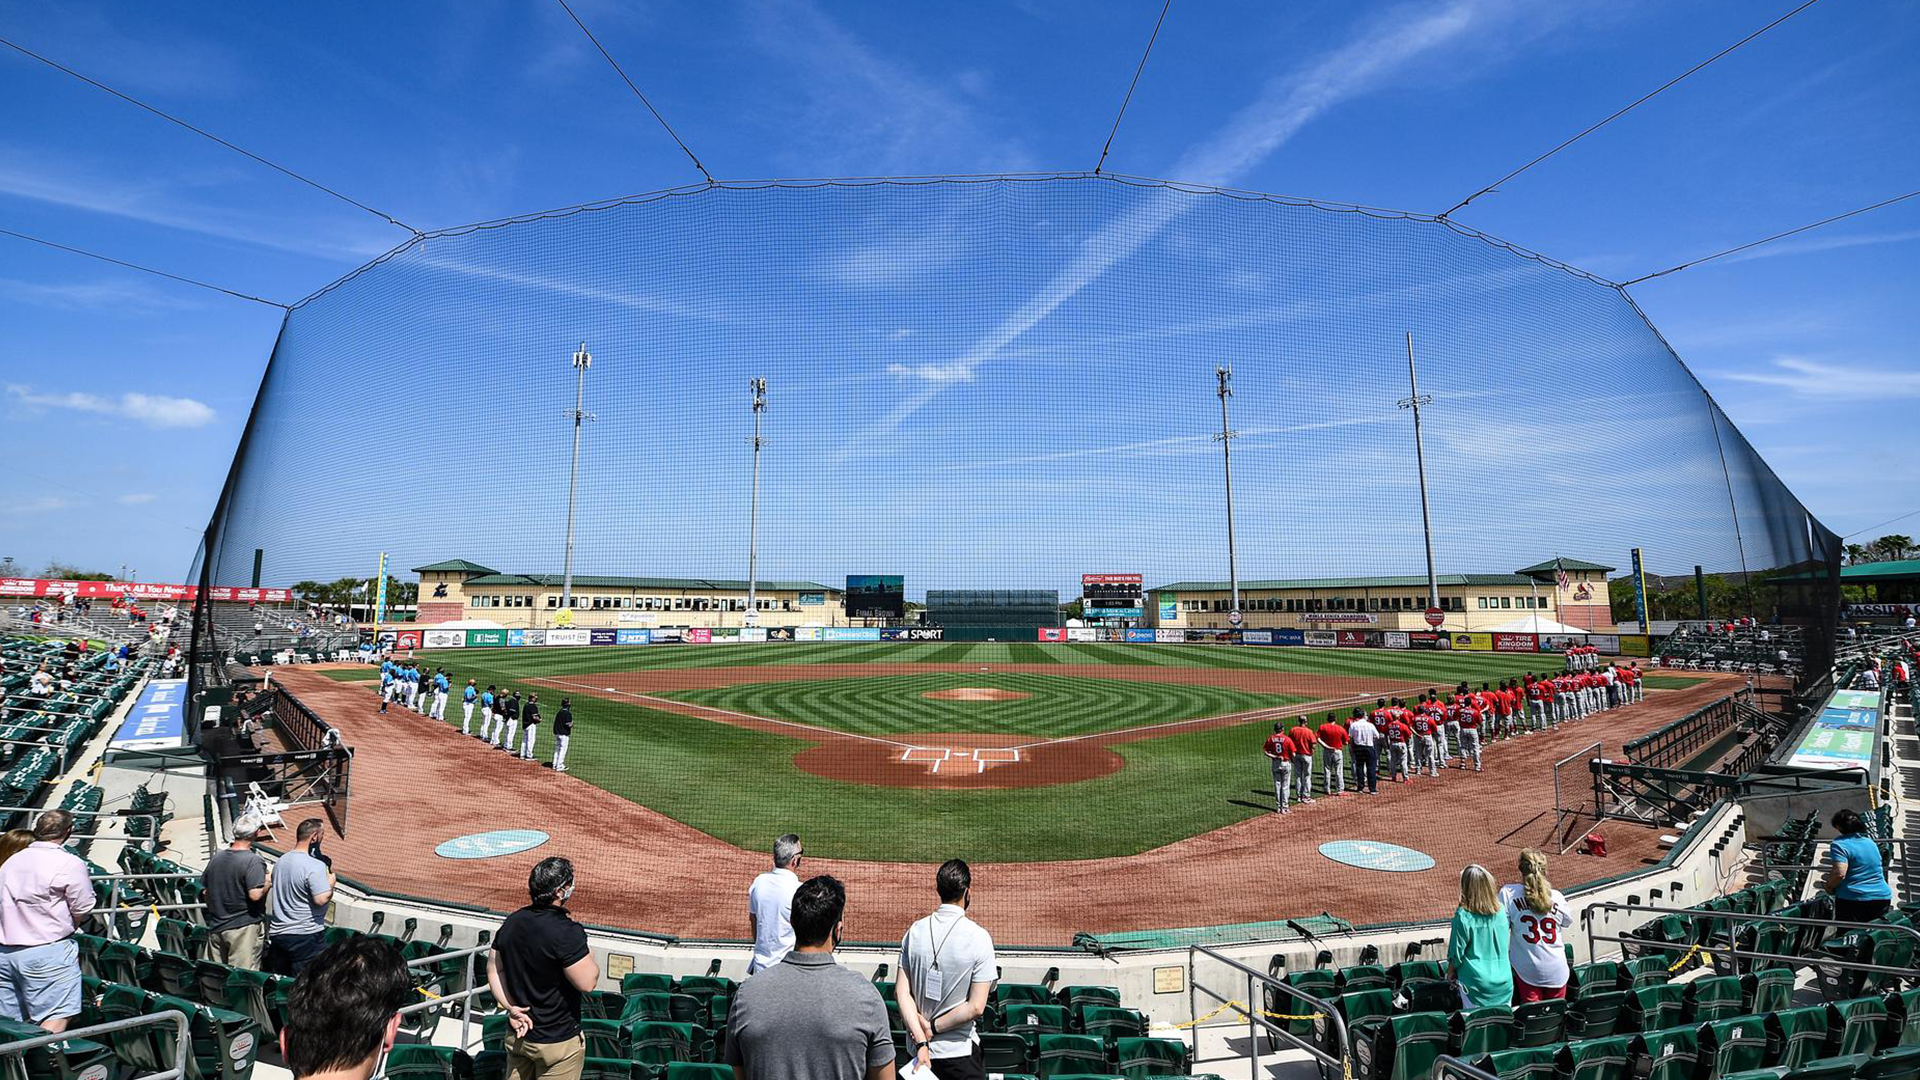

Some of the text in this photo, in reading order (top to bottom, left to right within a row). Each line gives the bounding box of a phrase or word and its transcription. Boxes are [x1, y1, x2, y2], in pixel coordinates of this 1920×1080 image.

[105, 583, 131, 592] That's
[132, 584, 146, 593] All
[147, 585, 163, 593] You
[1633, 556, 1645, 621] SEACOAST
[874, 609, 896, 617] BROWN
[910, 629, 943, 640] SPORT
[1460, 713, 1473, 723] 28
[1519, 914, 1557, 945] 39
